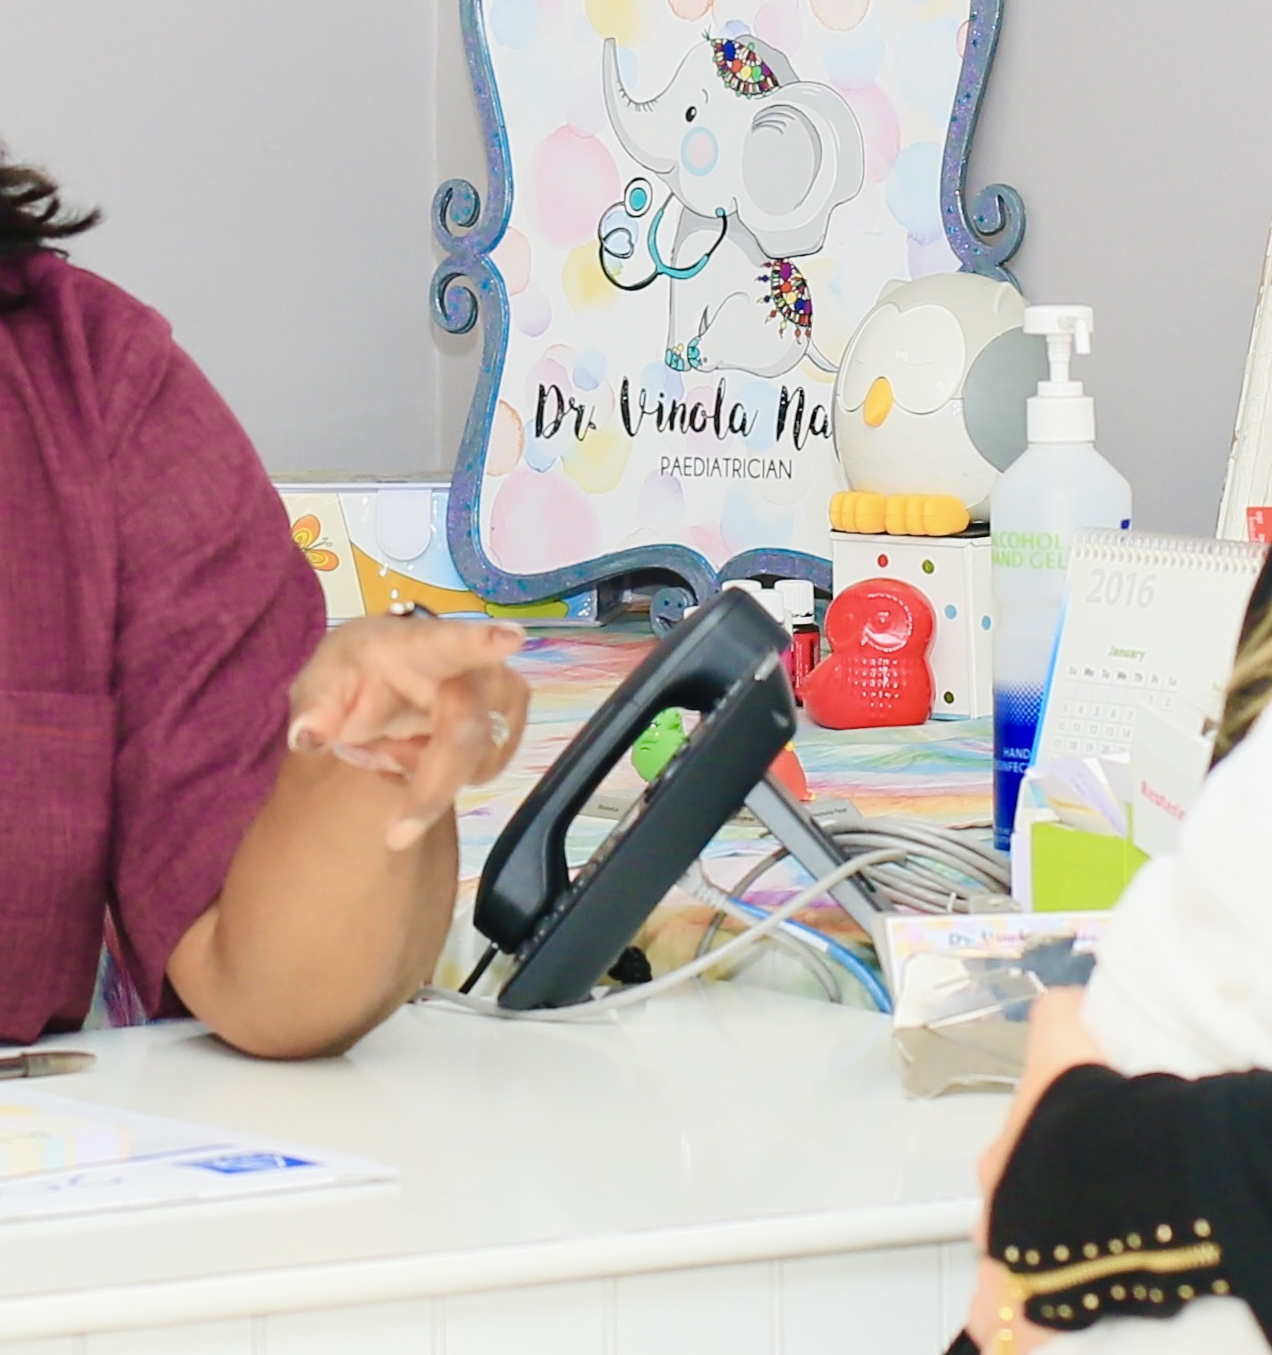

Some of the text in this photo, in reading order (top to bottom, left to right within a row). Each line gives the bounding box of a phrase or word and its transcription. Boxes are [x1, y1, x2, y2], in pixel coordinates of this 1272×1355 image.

[534, 382, 597, 442] Dr.
[620, 375, 759, 441] Vinola
[660, 456, 792, 479] PAEDIATRICIAN
[1029, 551, 1068, 570] GEL
[1086, 568, 1157, 609] 2016
[1108, 645, 1146, 662] January
[1002, 747, 1031, 760] HAND
